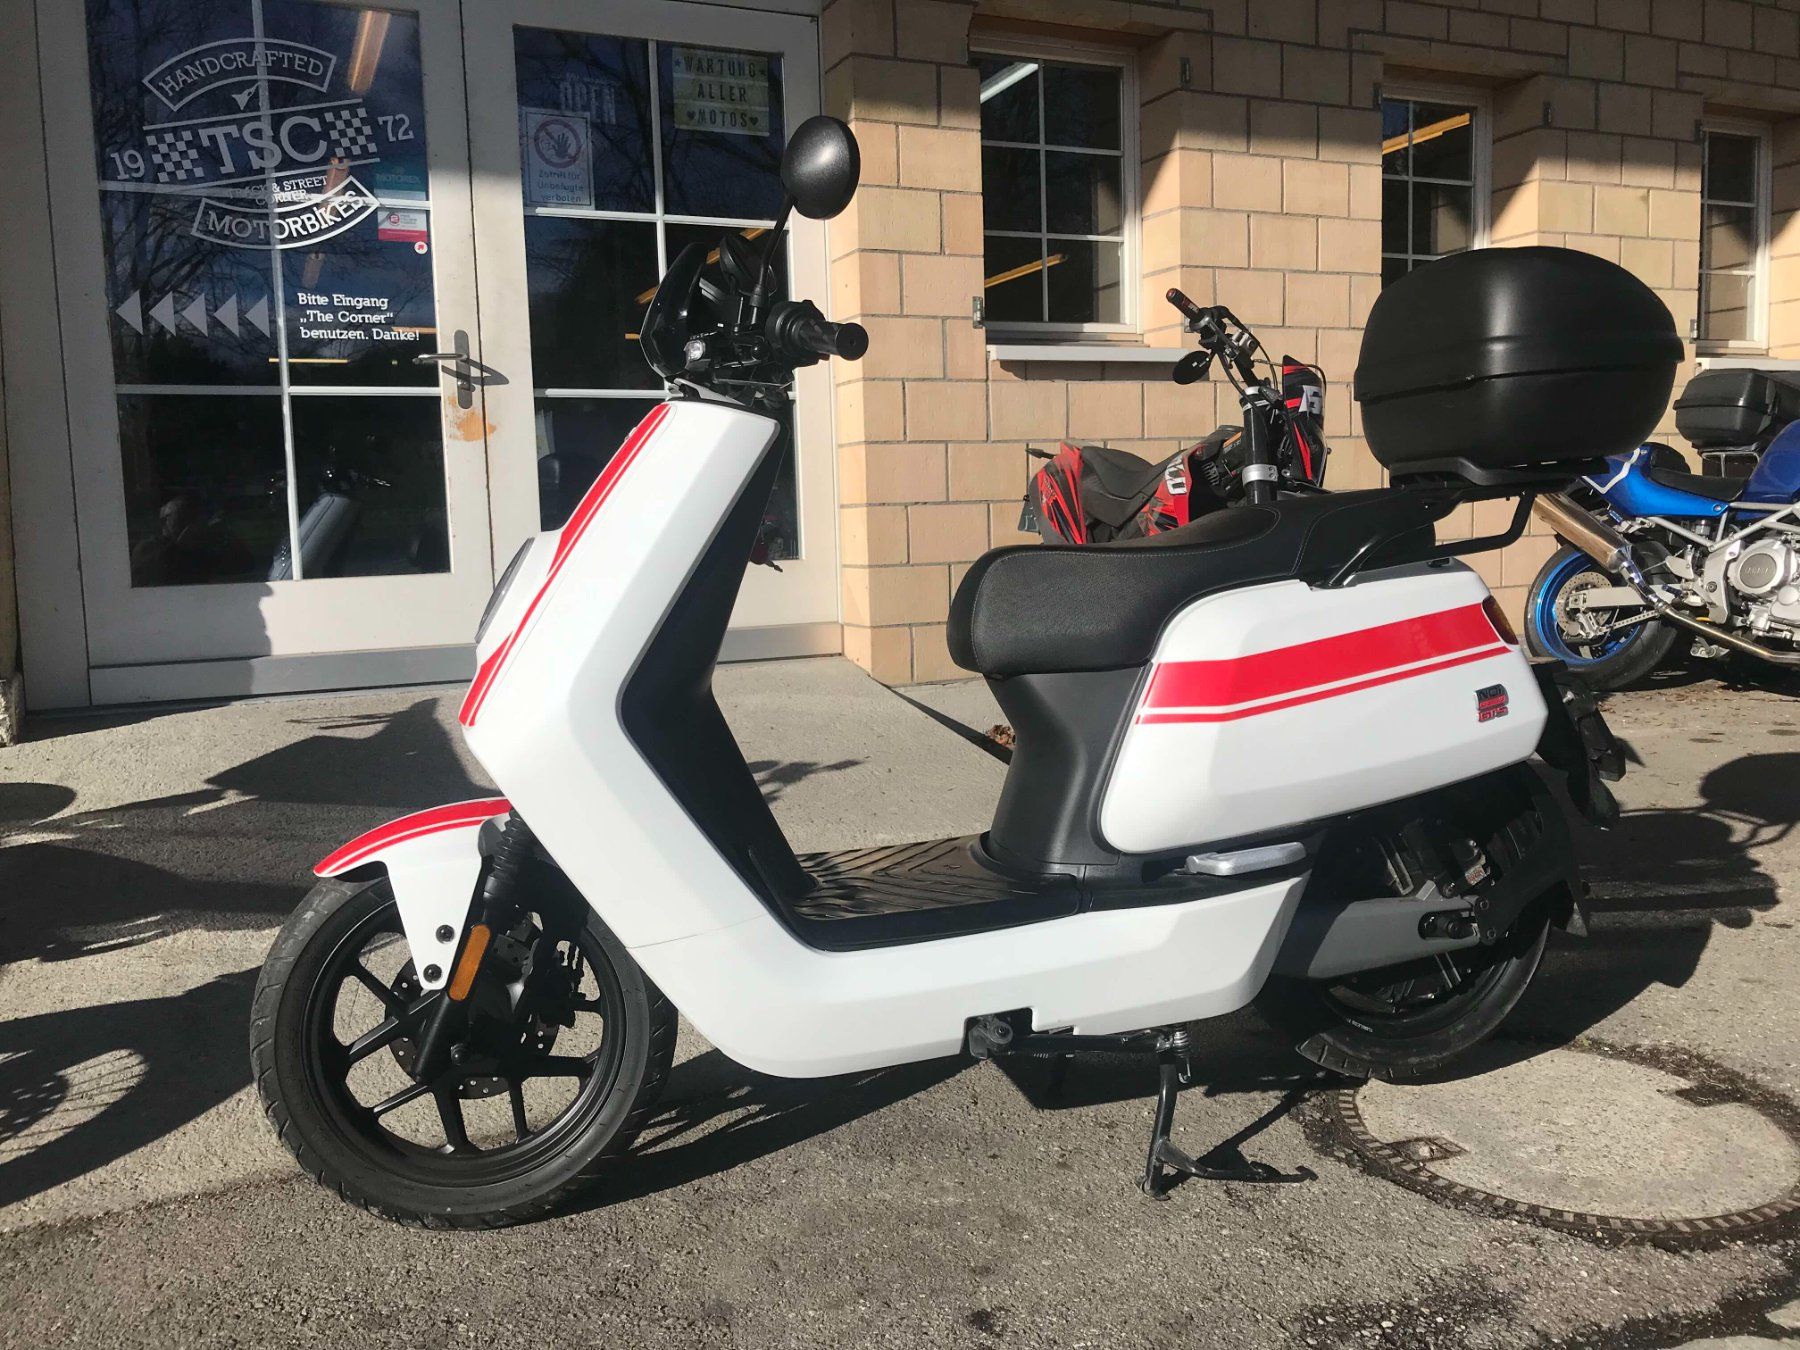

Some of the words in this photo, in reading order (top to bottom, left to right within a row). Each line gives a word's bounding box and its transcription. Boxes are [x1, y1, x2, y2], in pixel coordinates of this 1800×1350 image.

[158, 50, 324, 97] HANDCRAFTED
[684, 55, 756, 78] WARTUNG
[698, 83, 747, 102] ALLER
[698, 108, 748, 127] MOTOS
[110, 149, 145, 180] 19
[199, 115, 327, 176] TSC
[378, 113, 415, 143] 72
[271, 182, 280, 193] &
[284, 175, 328, 191] STREET
[297, 292, 329, 305] Bitte
[332, 293, 389, 310] Eingang
[300, 326, 369, 340] benutzen.
[372, 328, 420, 341] Danke!
